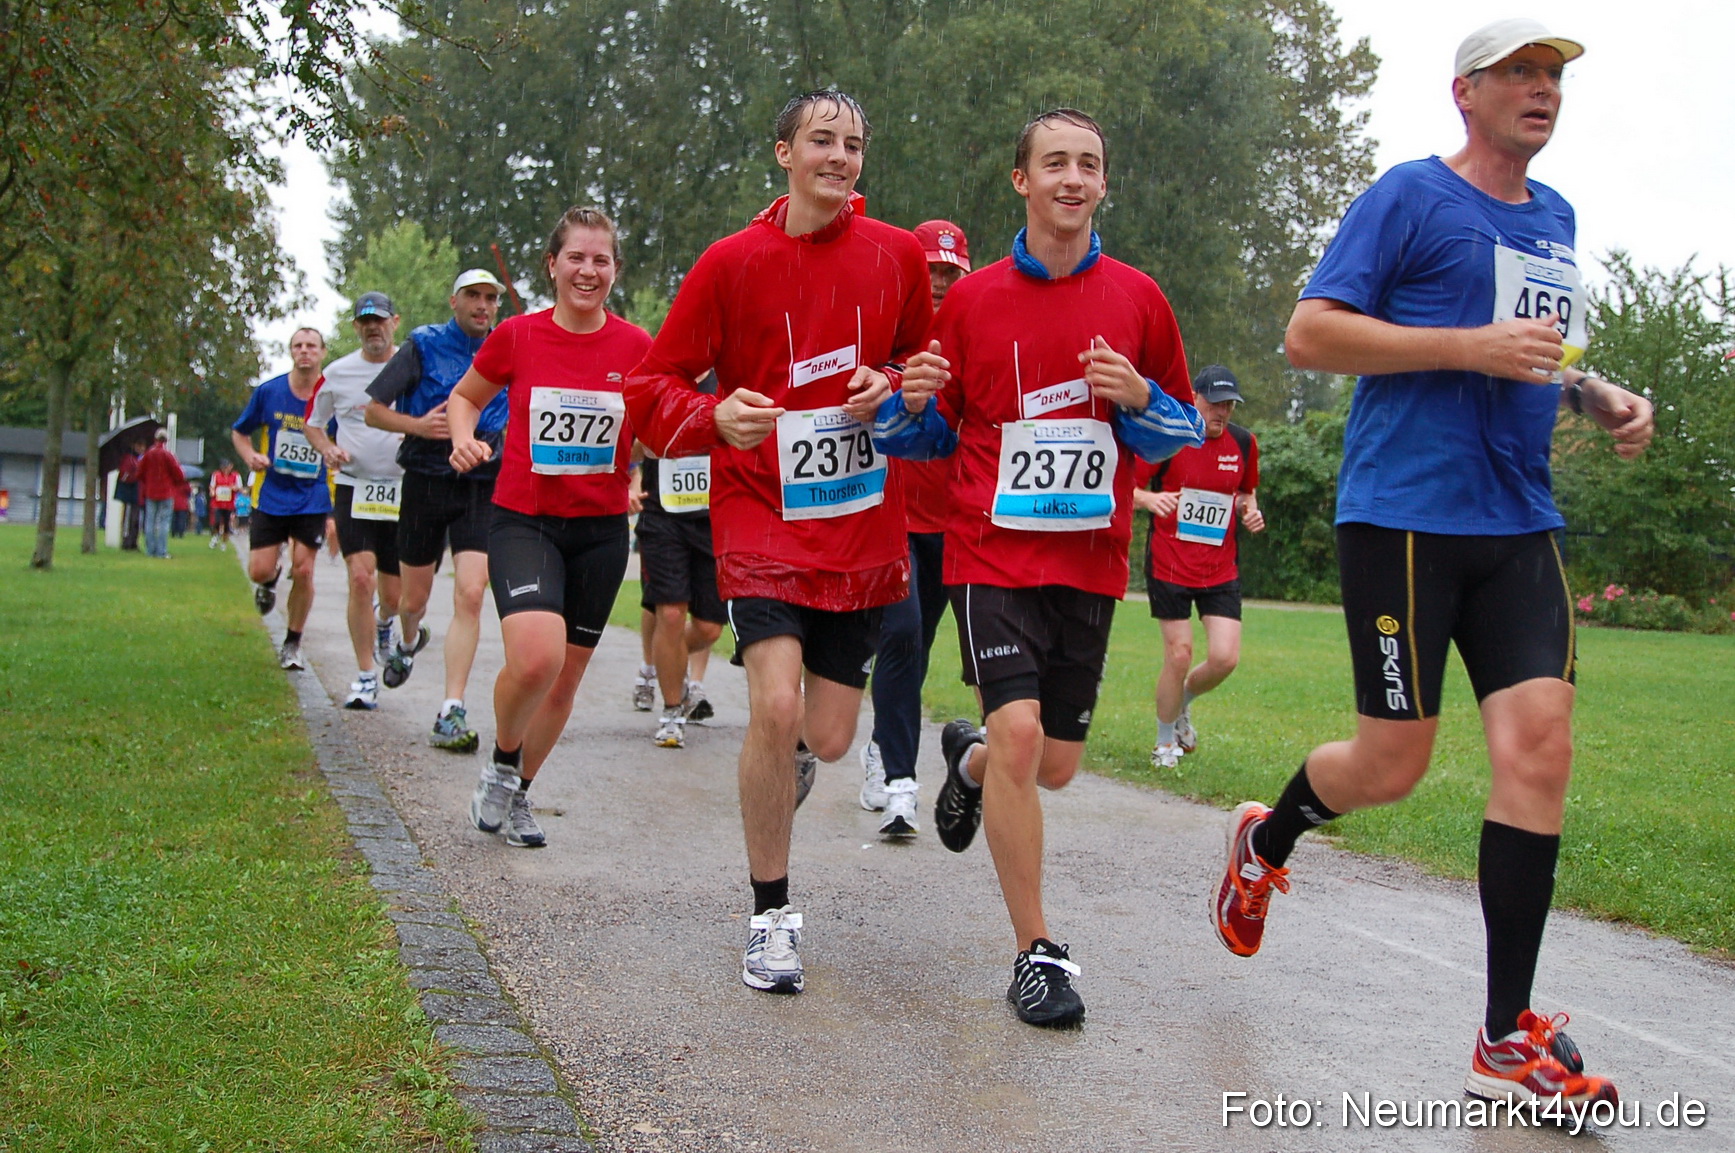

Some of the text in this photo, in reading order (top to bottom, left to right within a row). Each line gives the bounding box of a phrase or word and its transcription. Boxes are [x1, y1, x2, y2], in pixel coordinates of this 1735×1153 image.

[1515, 287, 1571, 339] 469
[811, 357, 839, 375] DEHN
[1040, 388, 1071, 406] DEHN
[538, 411, 615, 445] 2372
[279, 443, 318, 463] 2535
[557, 449, 590, 463] Sarah
[791, 429, 875, 480] 2379
[1010, 449, 1107, 490] 2378
[672, 471, 708, 492] 506
[365, 484, 396, 504] 284
[808, 481, 867, 504] Thorsten
[1032, 498, 1079, 516] Lukas
[1182, 502, 1227, 526] 3407
